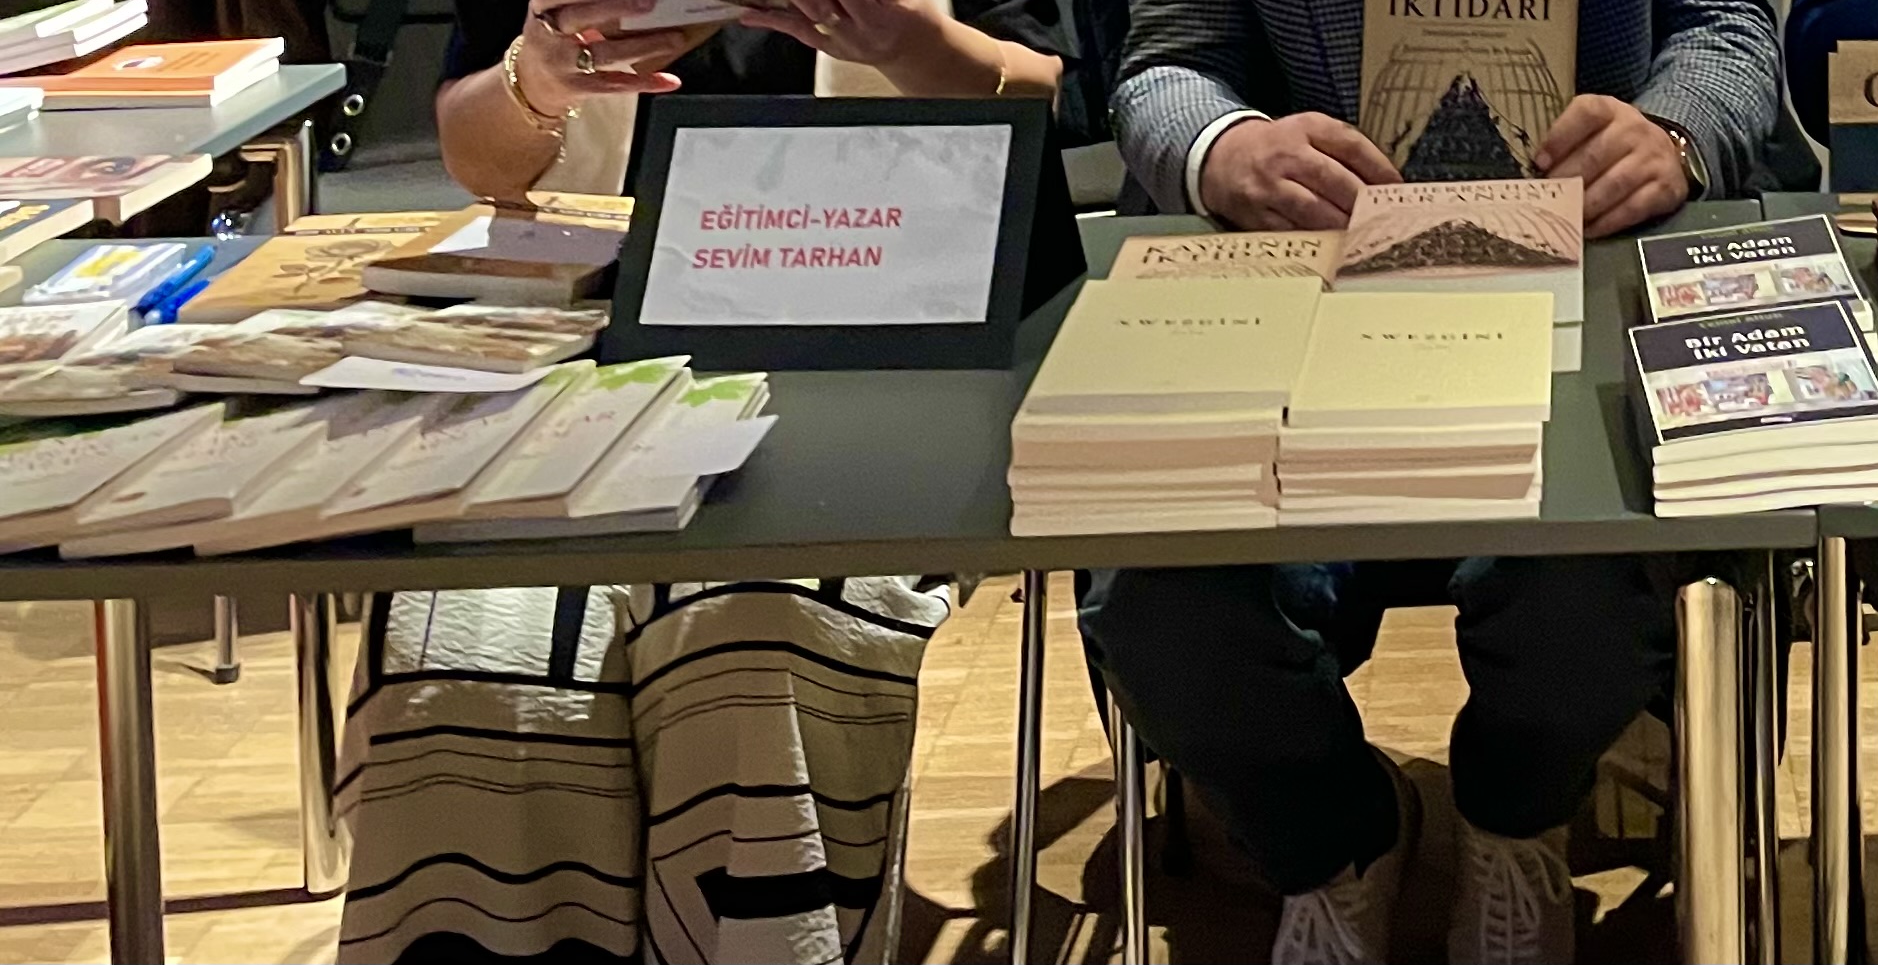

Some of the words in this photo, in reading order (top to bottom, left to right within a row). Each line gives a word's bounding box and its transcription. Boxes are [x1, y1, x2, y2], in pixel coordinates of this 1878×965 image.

[701, 204, 902, 231] EĞİTİMCİ-YAZAR
[1727, 236, 1792, 251] Adam
[1729, 245, 1796, 260] Vatan
[692, 243, 771, 269] SEVİM
[779, 245, 883, 268] TARHAN
[1684, 335, 1722, 349] Bir
[1731, 325, 1806, 343] Adam
[1734, 337, 1810, 355] Vatan
